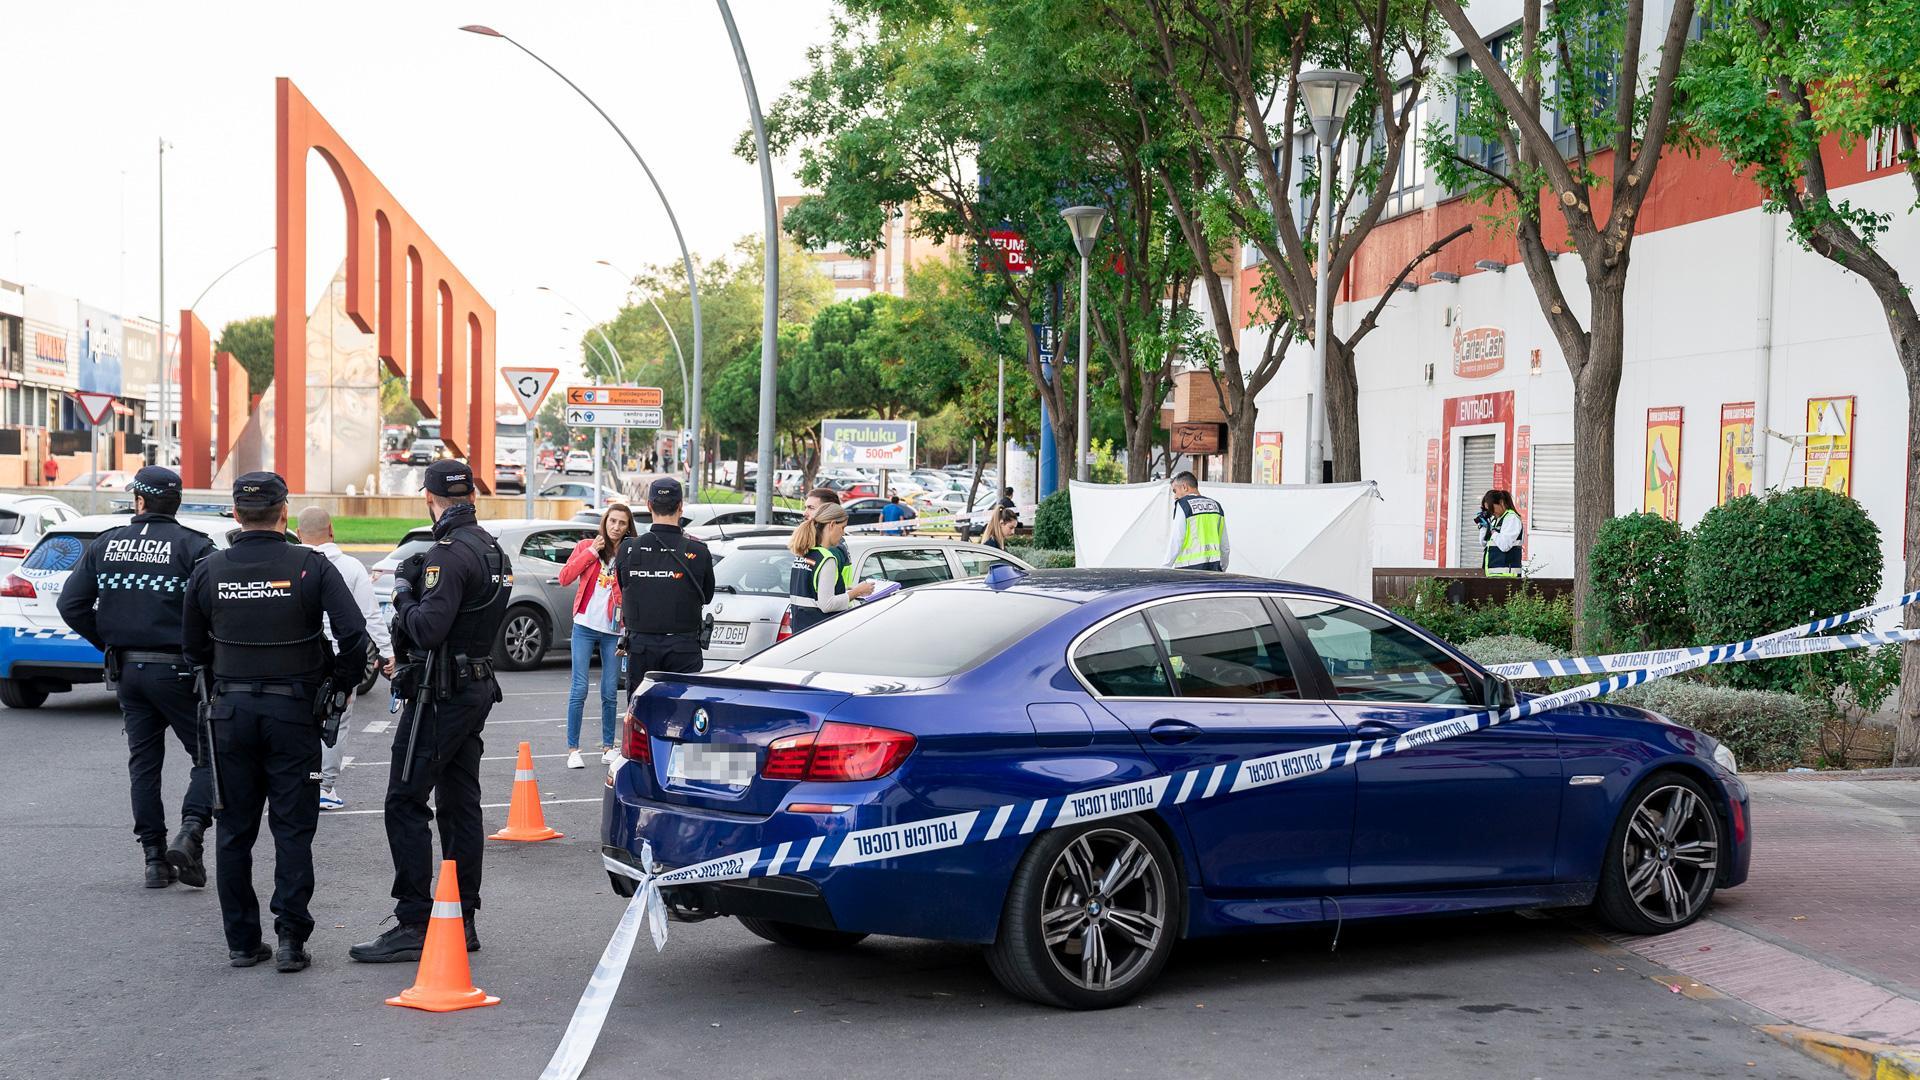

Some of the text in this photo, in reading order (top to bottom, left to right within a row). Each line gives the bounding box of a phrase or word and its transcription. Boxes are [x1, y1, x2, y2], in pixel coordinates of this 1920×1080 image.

[1461, 399, 1494, 420] ENTRADA
[865, 448, 893, 459] 500m
[243, 485, 260, 493] CNP
[1191, 502, 1219, 513] POLICIA
[105, 539, 172, 555] POLICIA
[103, 552, 171, 565] FUENLABRADA
[629, 570, 675, 578] POLICIA
[41, 582, 60, 591] 092
[217, 580, 274, 592] POLICIA
[218, 589, 292, 600] NACIONAL
[712, 626, 745, 641] 37 DGH
[1246, 753, 1323, 783] POLICIA LOCAL
[1071, 785, 1153, 818] POLICIA LOCAL
[853, 821, 958, 856] POLICIA LOCAL
